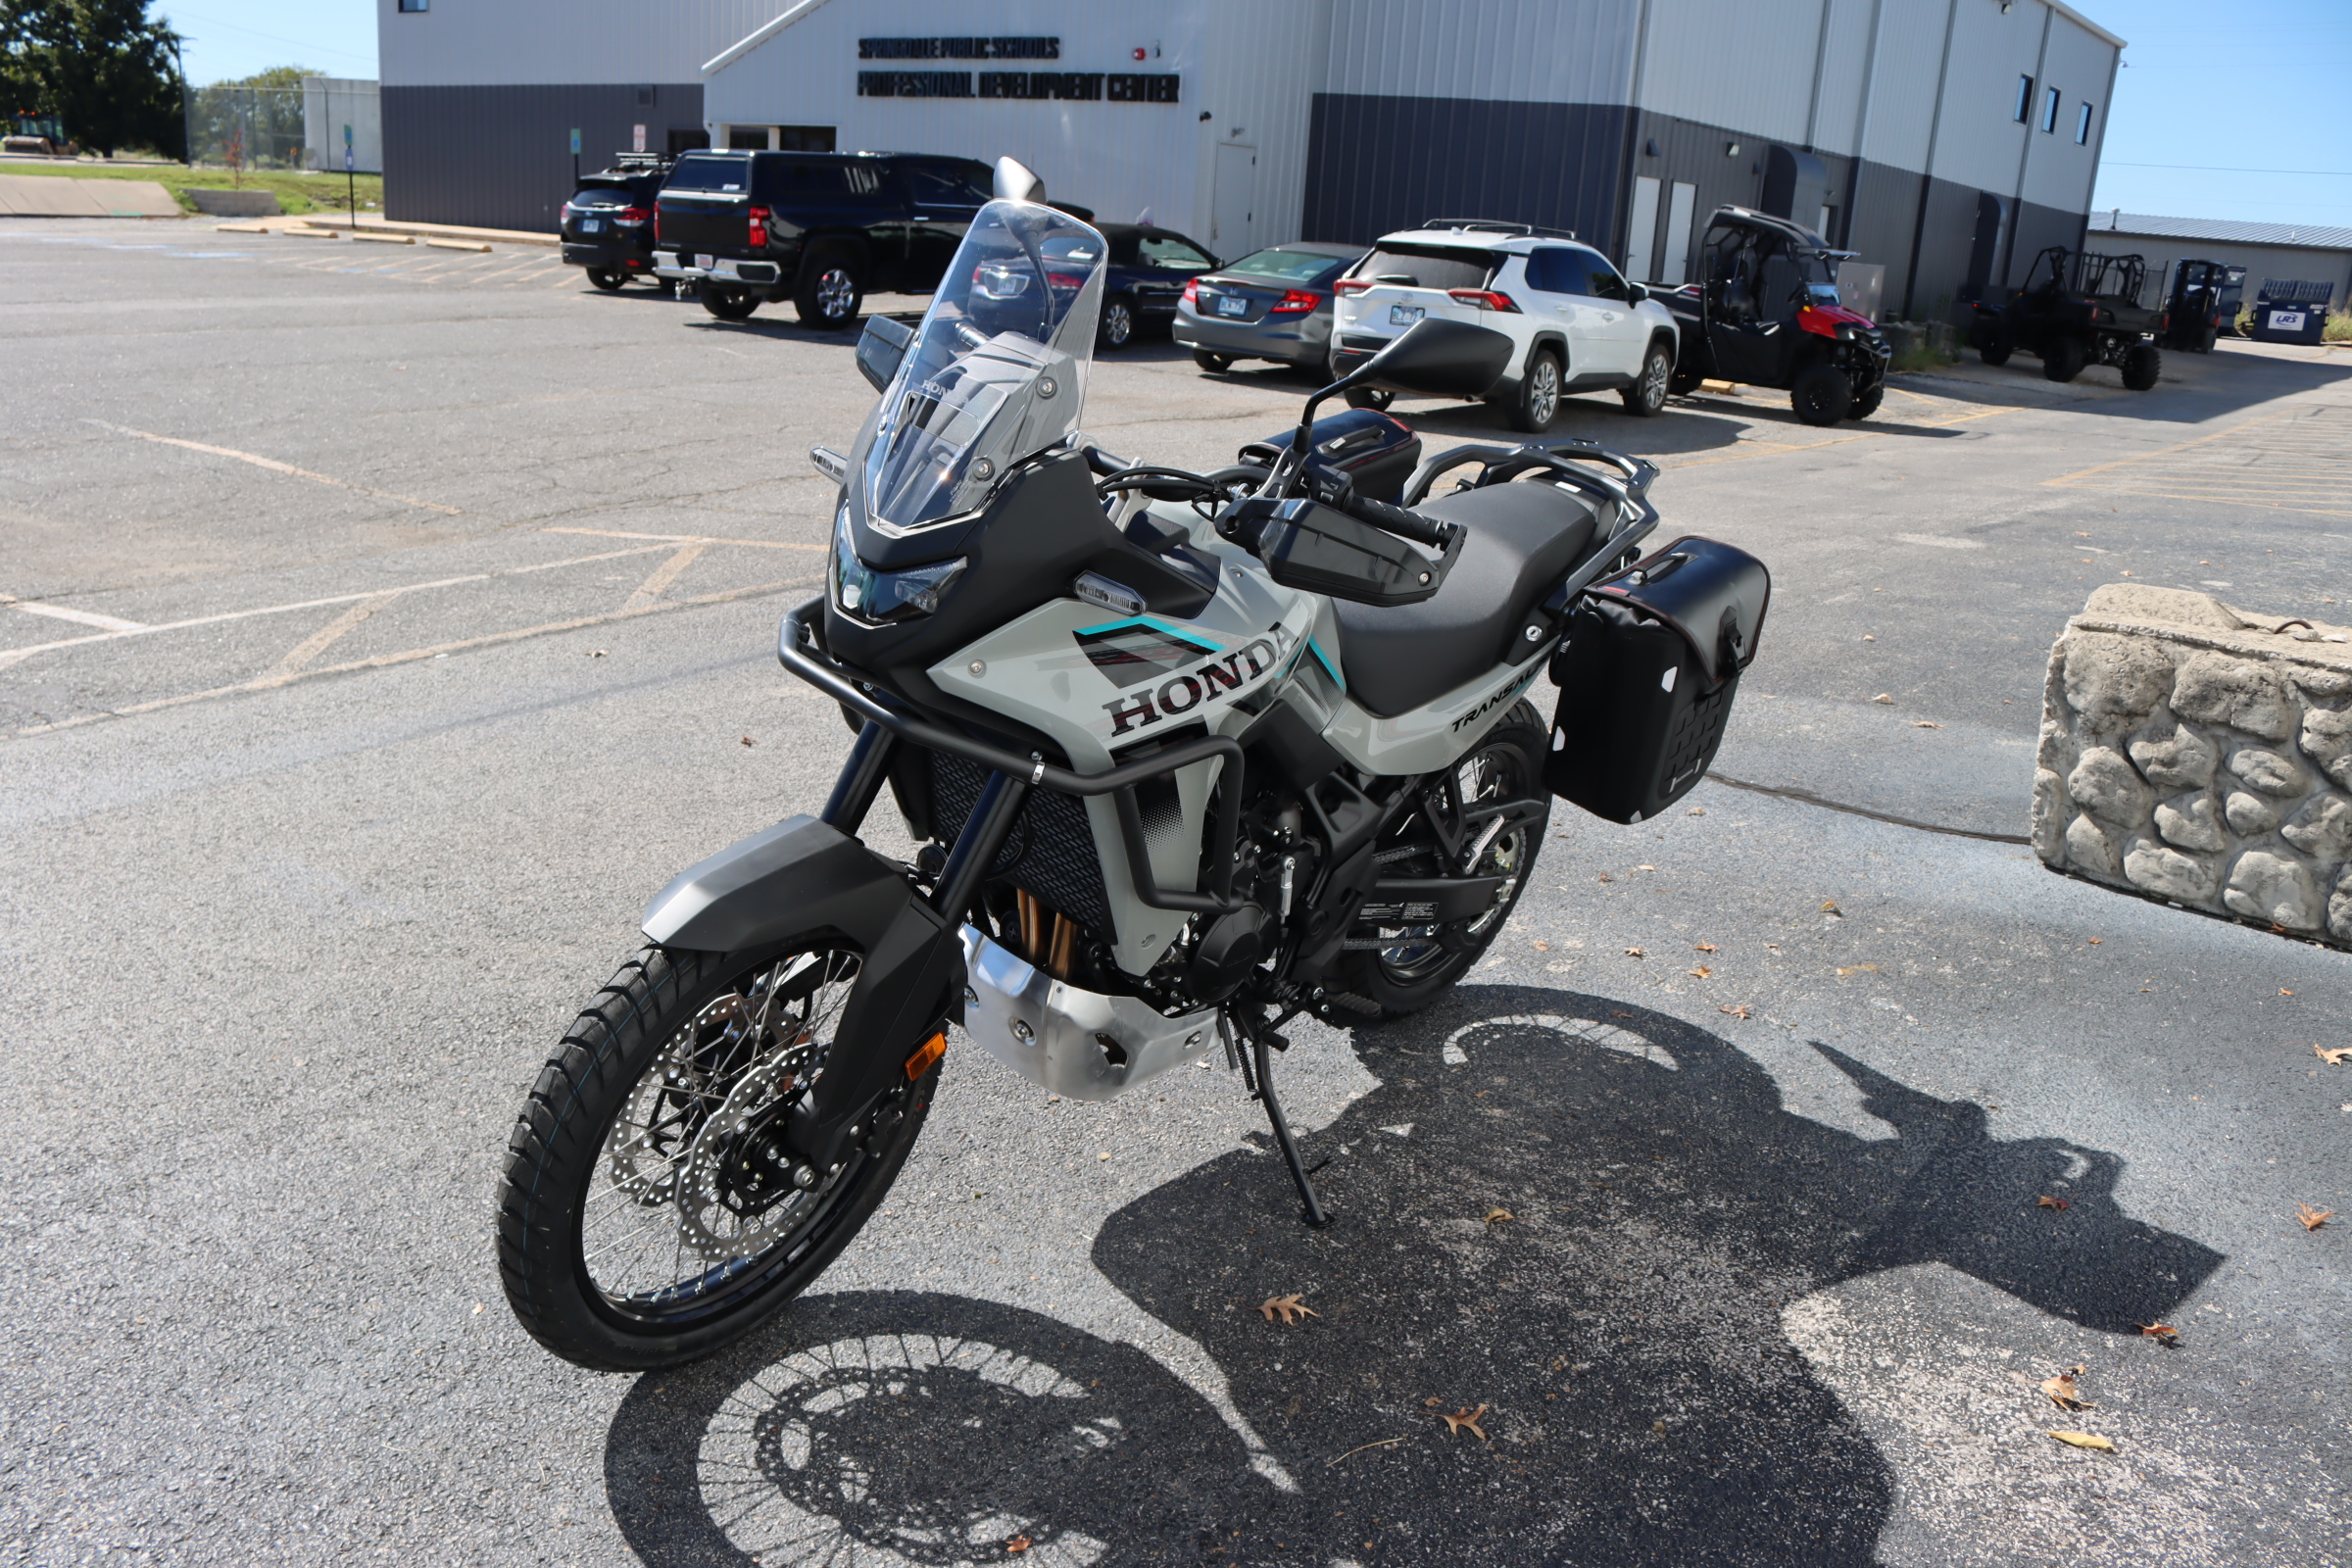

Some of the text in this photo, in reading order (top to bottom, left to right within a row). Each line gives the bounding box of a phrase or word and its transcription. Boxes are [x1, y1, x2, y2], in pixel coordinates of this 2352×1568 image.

[858, 36, 1059, 59] SPRINGDALE PUBLIC SCHOOLS
[858, 71, 1180, 103] PROFESSIONAL DEVELOPMENT CENTER
[2276, 315, 2298, 323] LRS
[1102, 621, 1299, 737] HONDA
